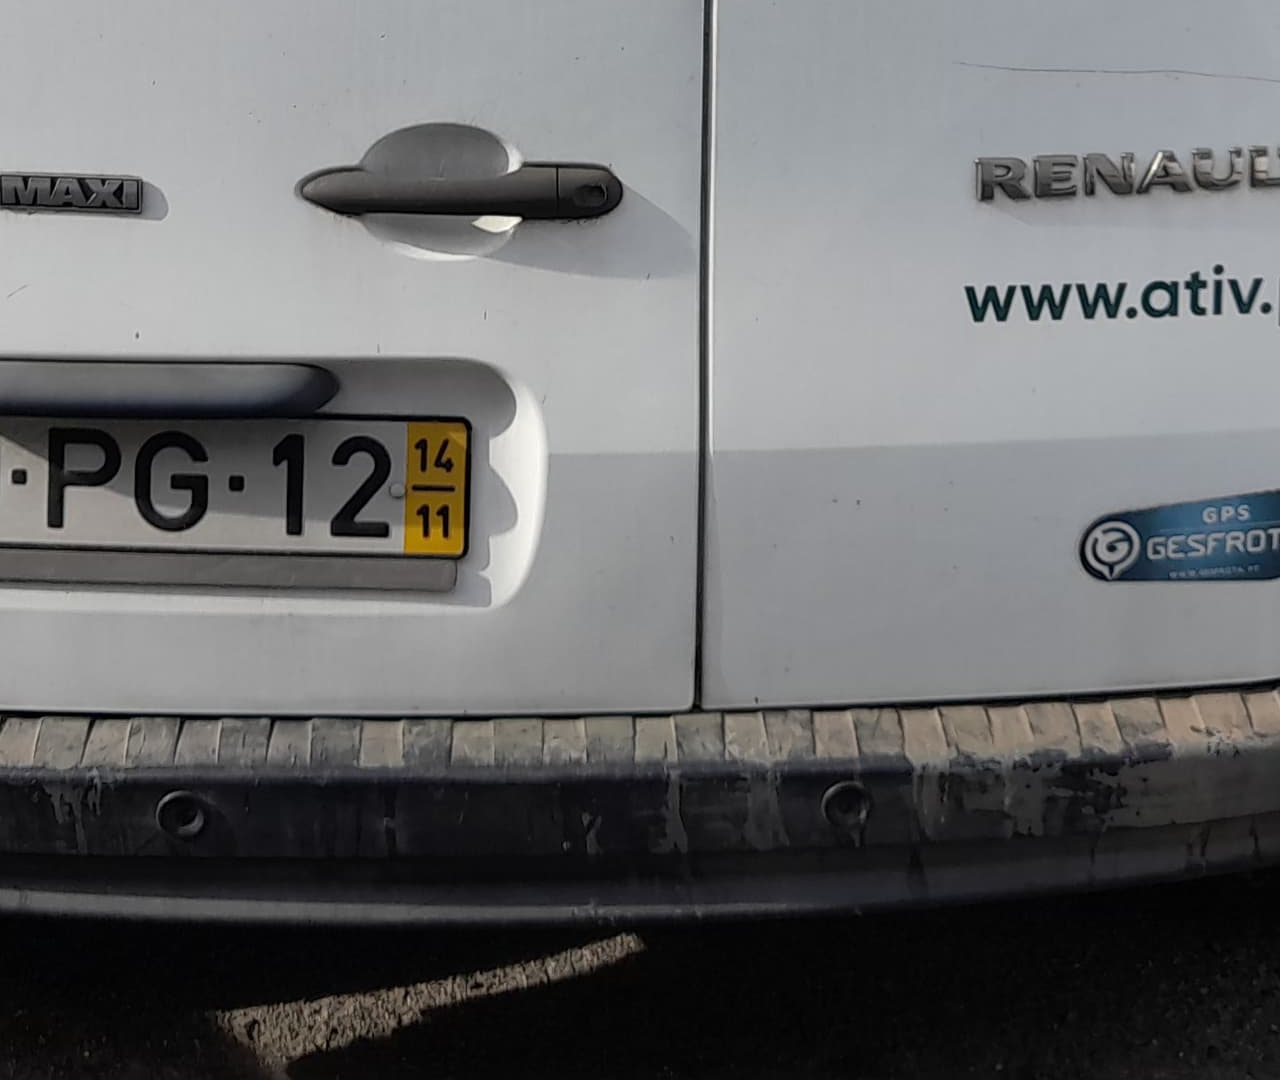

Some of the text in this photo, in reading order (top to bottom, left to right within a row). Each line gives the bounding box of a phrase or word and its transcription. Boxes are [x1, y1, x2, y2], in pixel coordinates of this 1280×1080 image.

[1, 174, 140, 210] MAXI
[414, 438, 454, 474] 14
[415, 503, 452, 540] 11
[1201, 504, 1251, 524] GPS
